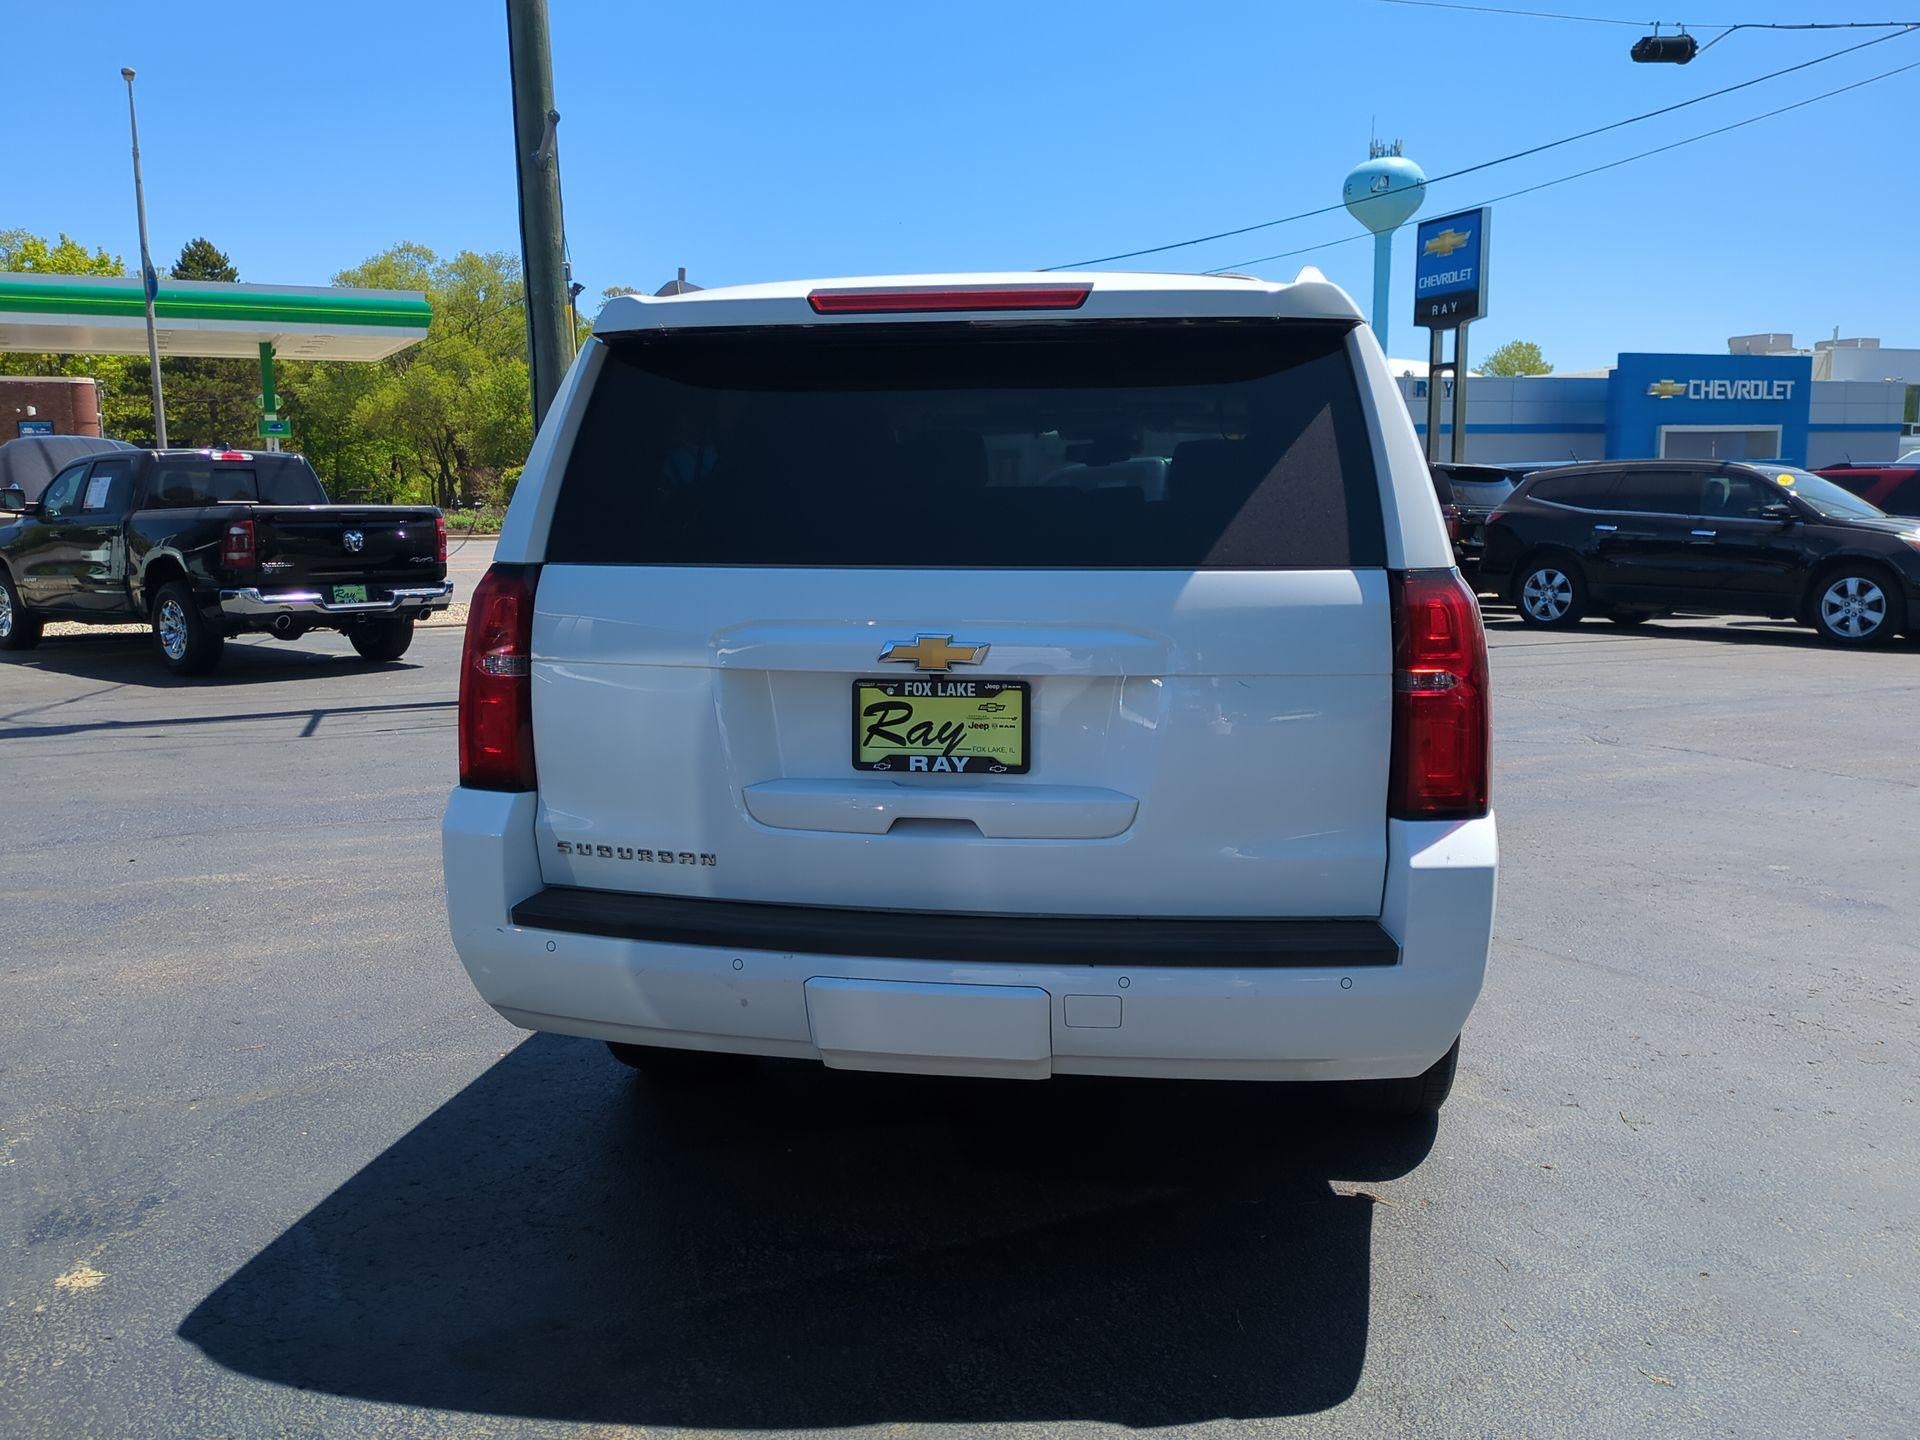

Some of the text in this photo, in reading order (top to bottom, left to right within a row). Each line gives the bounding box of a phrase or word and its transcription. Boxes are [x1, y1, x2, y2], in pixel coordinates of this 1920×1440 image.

[1418, 268, 1472, 289] CHEVROLET
[1432, 301, 1458, 316] RAY
[1415, 381, 1454, 398] RY
[1688, 379, 1796, 400] CHEVROLET
[904, 682, 976, 697] FOX LAKE
[862, 701, 967, 756] Ray
[968, 722, 990, 731] Jeep
[972, 745, 986, 753] FOX
[909, 756, 970, 772] RAY
[557, 841, 717, 866] SUBURBAN
